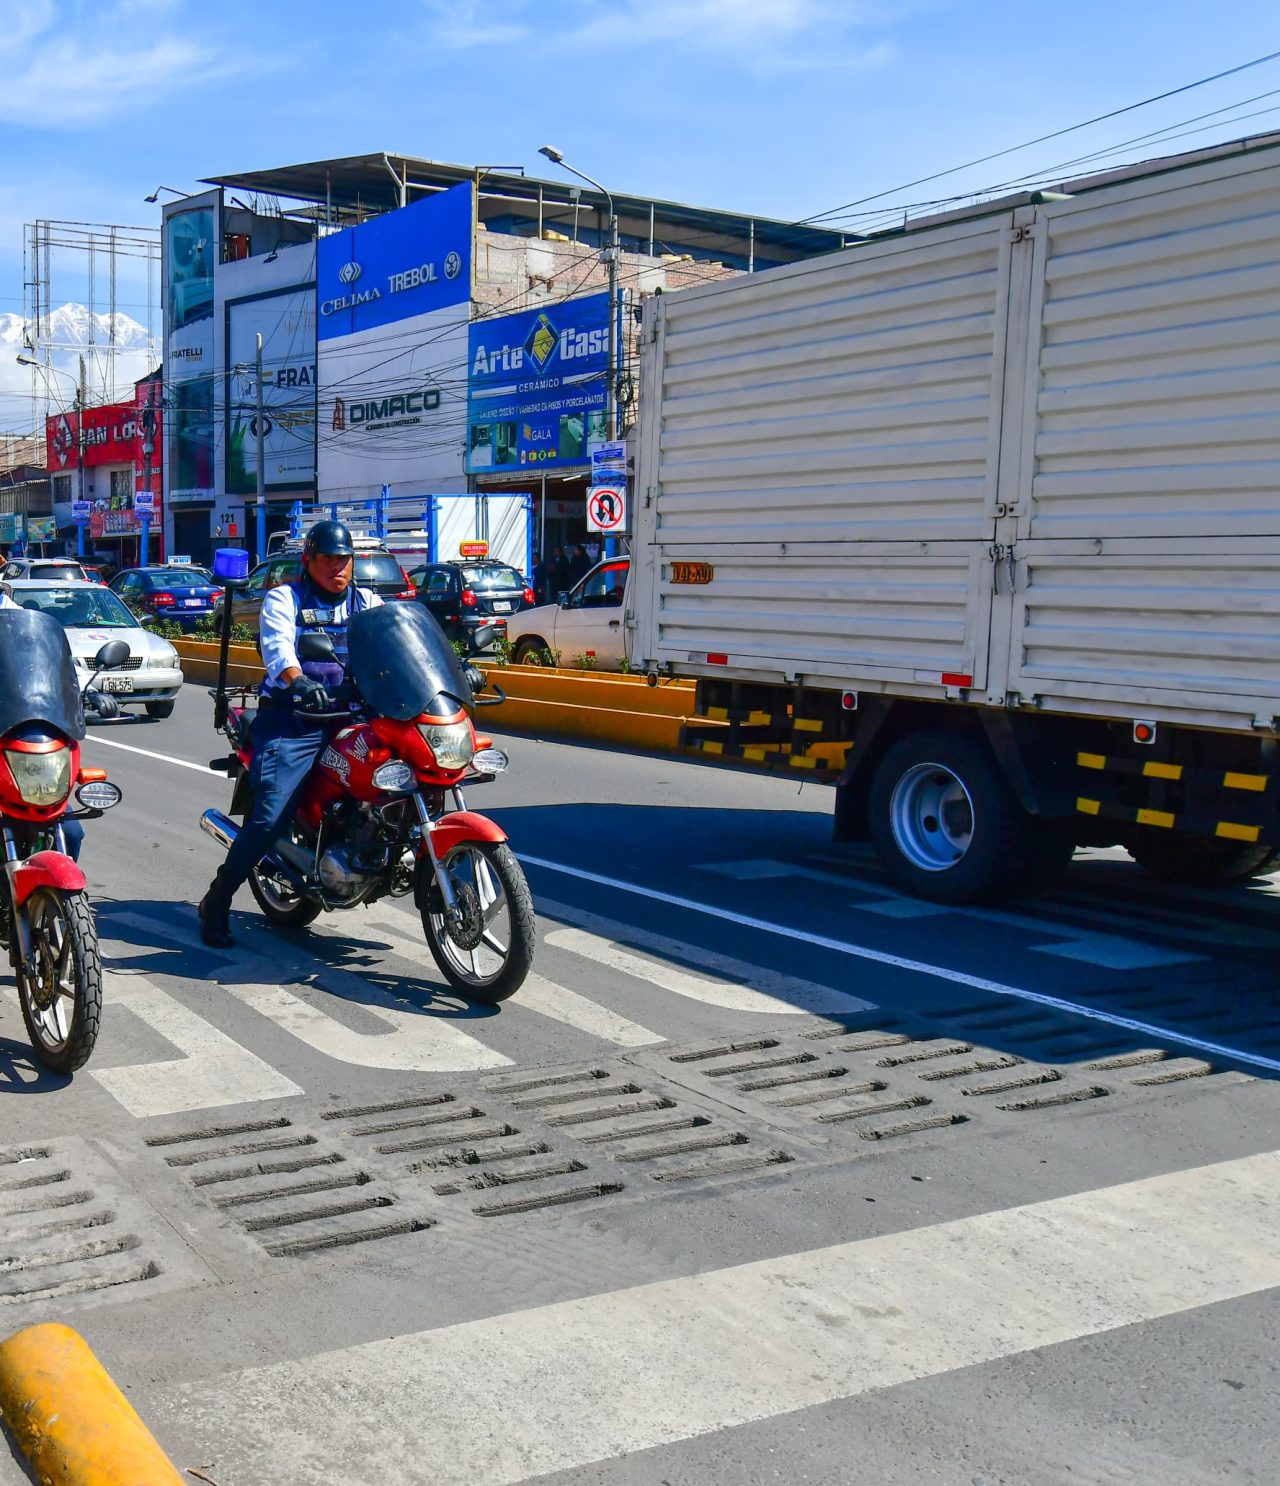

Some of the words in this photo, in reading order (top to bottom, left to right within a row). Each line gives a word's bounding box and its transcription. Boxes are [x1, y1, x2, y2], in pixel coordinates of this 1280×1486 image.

[388, 263, 438, 293] TREBOL
[321, 288, 381, 316] CELIMA
[172, 347, 202, 360] FRATELLI
[472, 344, 523, 376] Arte
[519, 378, 560, 393] CERÁMICO
[350, 390, 441, 424] DIMACO
[566, 393, 604, 408] PORCELANATOS
[532, 429, 551, 441] GALA
[220, 513, 234, 524] 121
